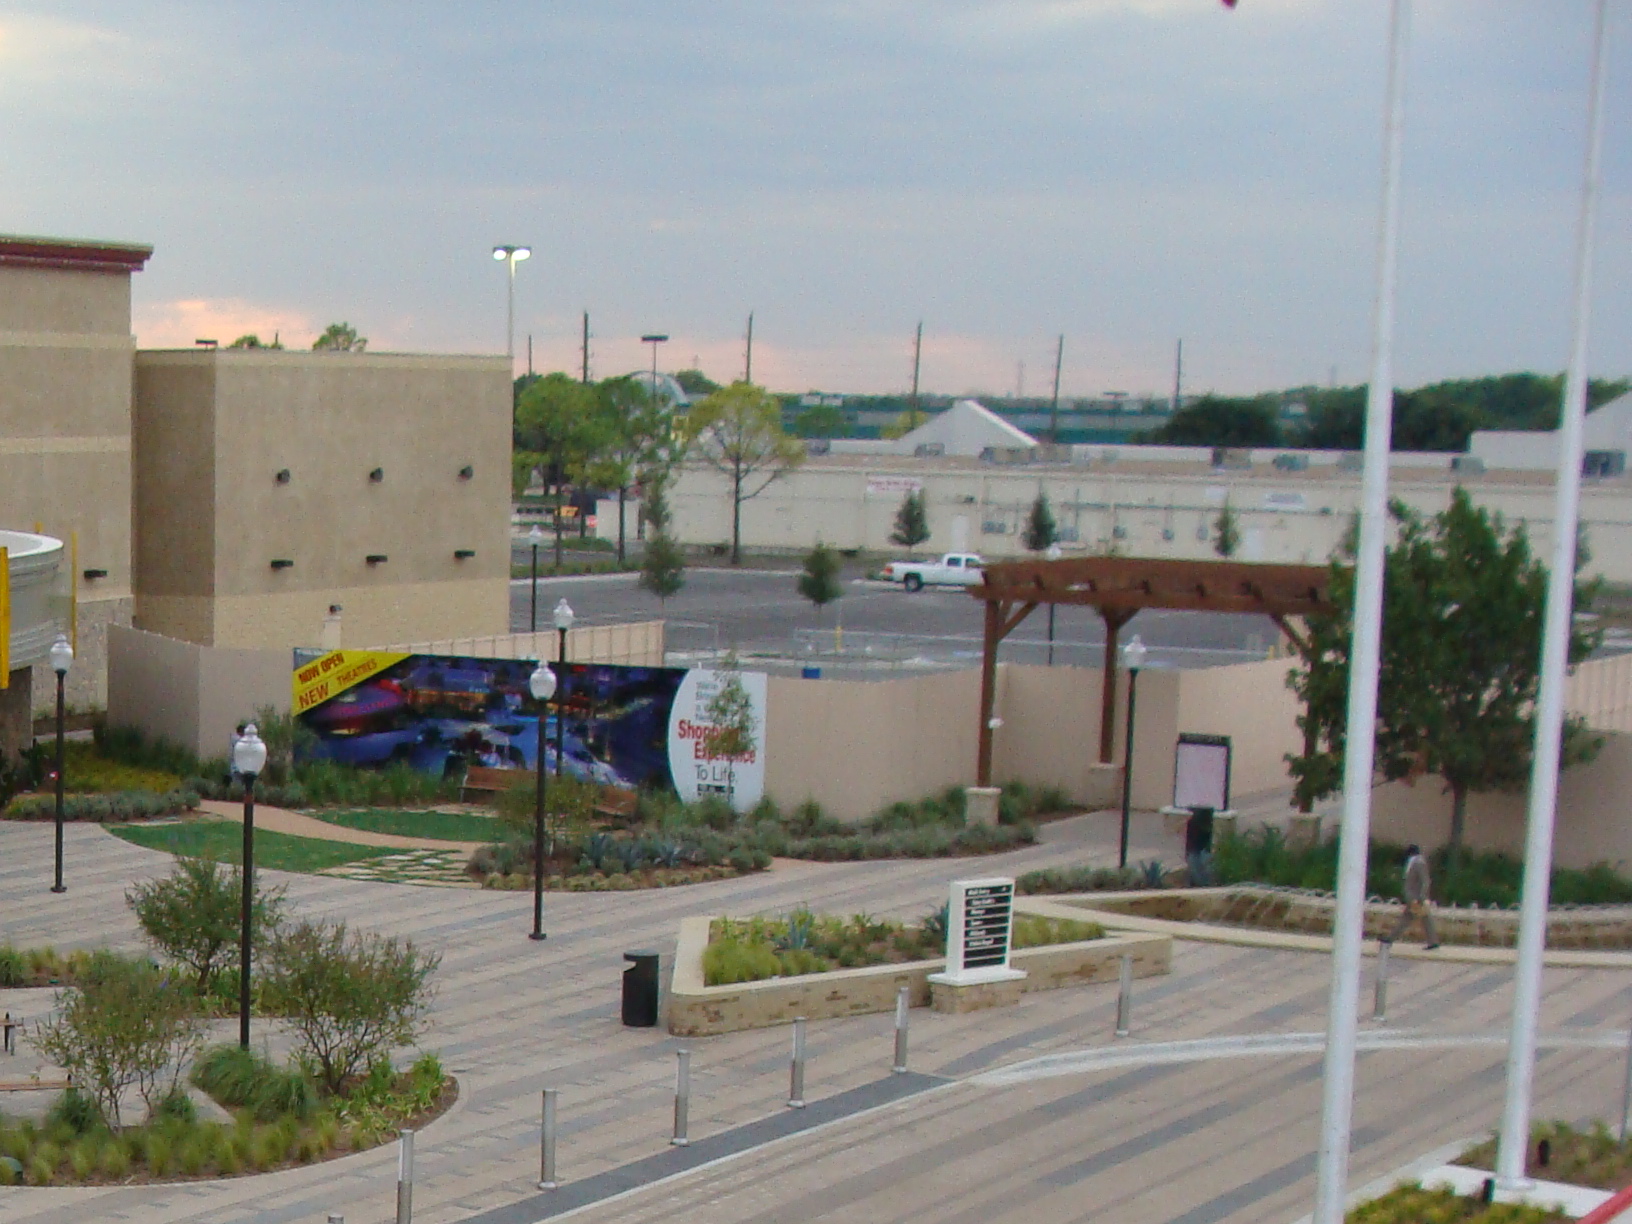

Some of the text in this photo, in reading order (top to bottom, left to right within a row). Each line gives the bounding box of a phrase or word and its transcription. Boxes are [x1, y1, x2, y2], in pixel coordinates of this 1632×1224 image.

[298, 652, 344, 684] NOW OPEN
[298, 682, 329, 708] NEW
[695, 764, 708, 781] To
